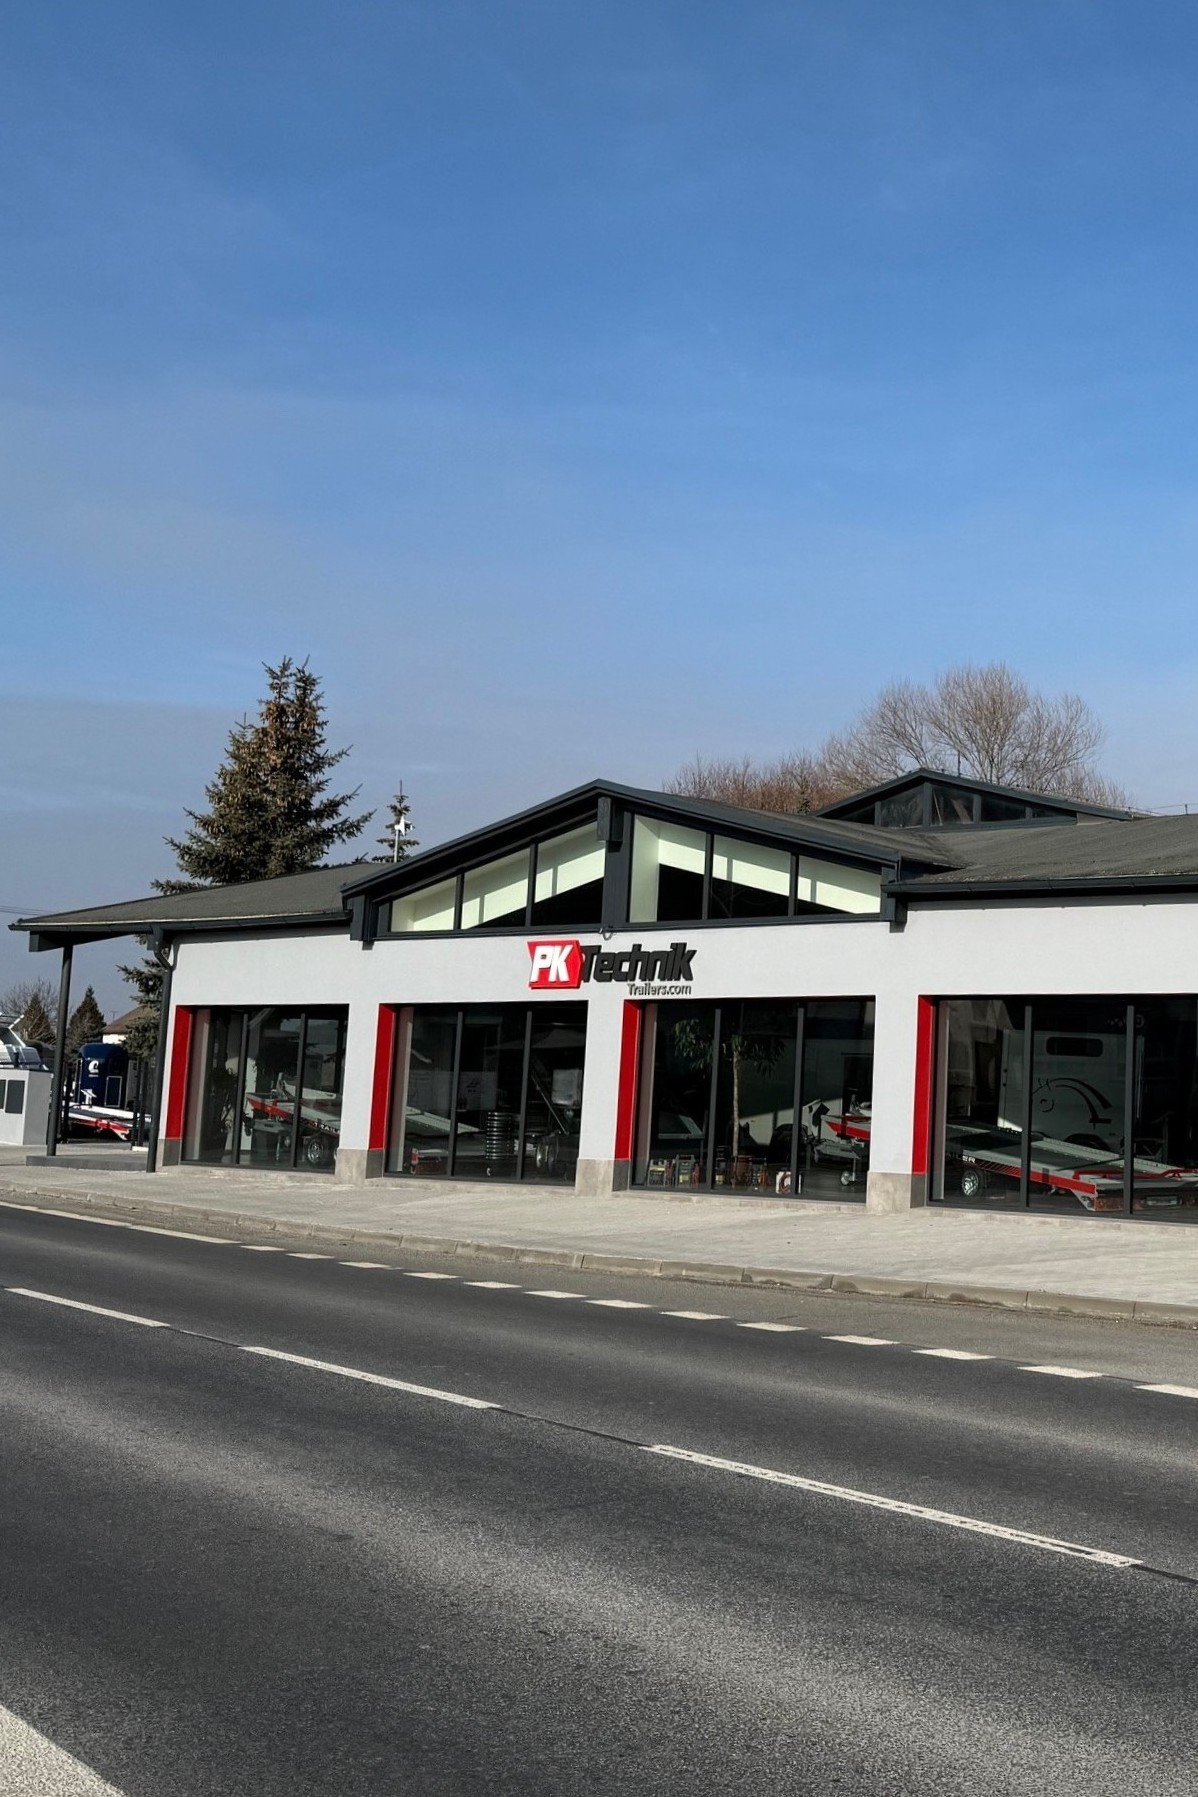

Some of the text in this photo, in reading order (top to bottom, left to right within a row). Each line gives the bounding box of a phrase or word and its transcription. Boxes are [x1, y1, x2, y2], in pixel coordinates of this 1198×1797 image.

[530, 942, 698, 983] PK Technik
[627, 983, 692, 996] Trailers.com
